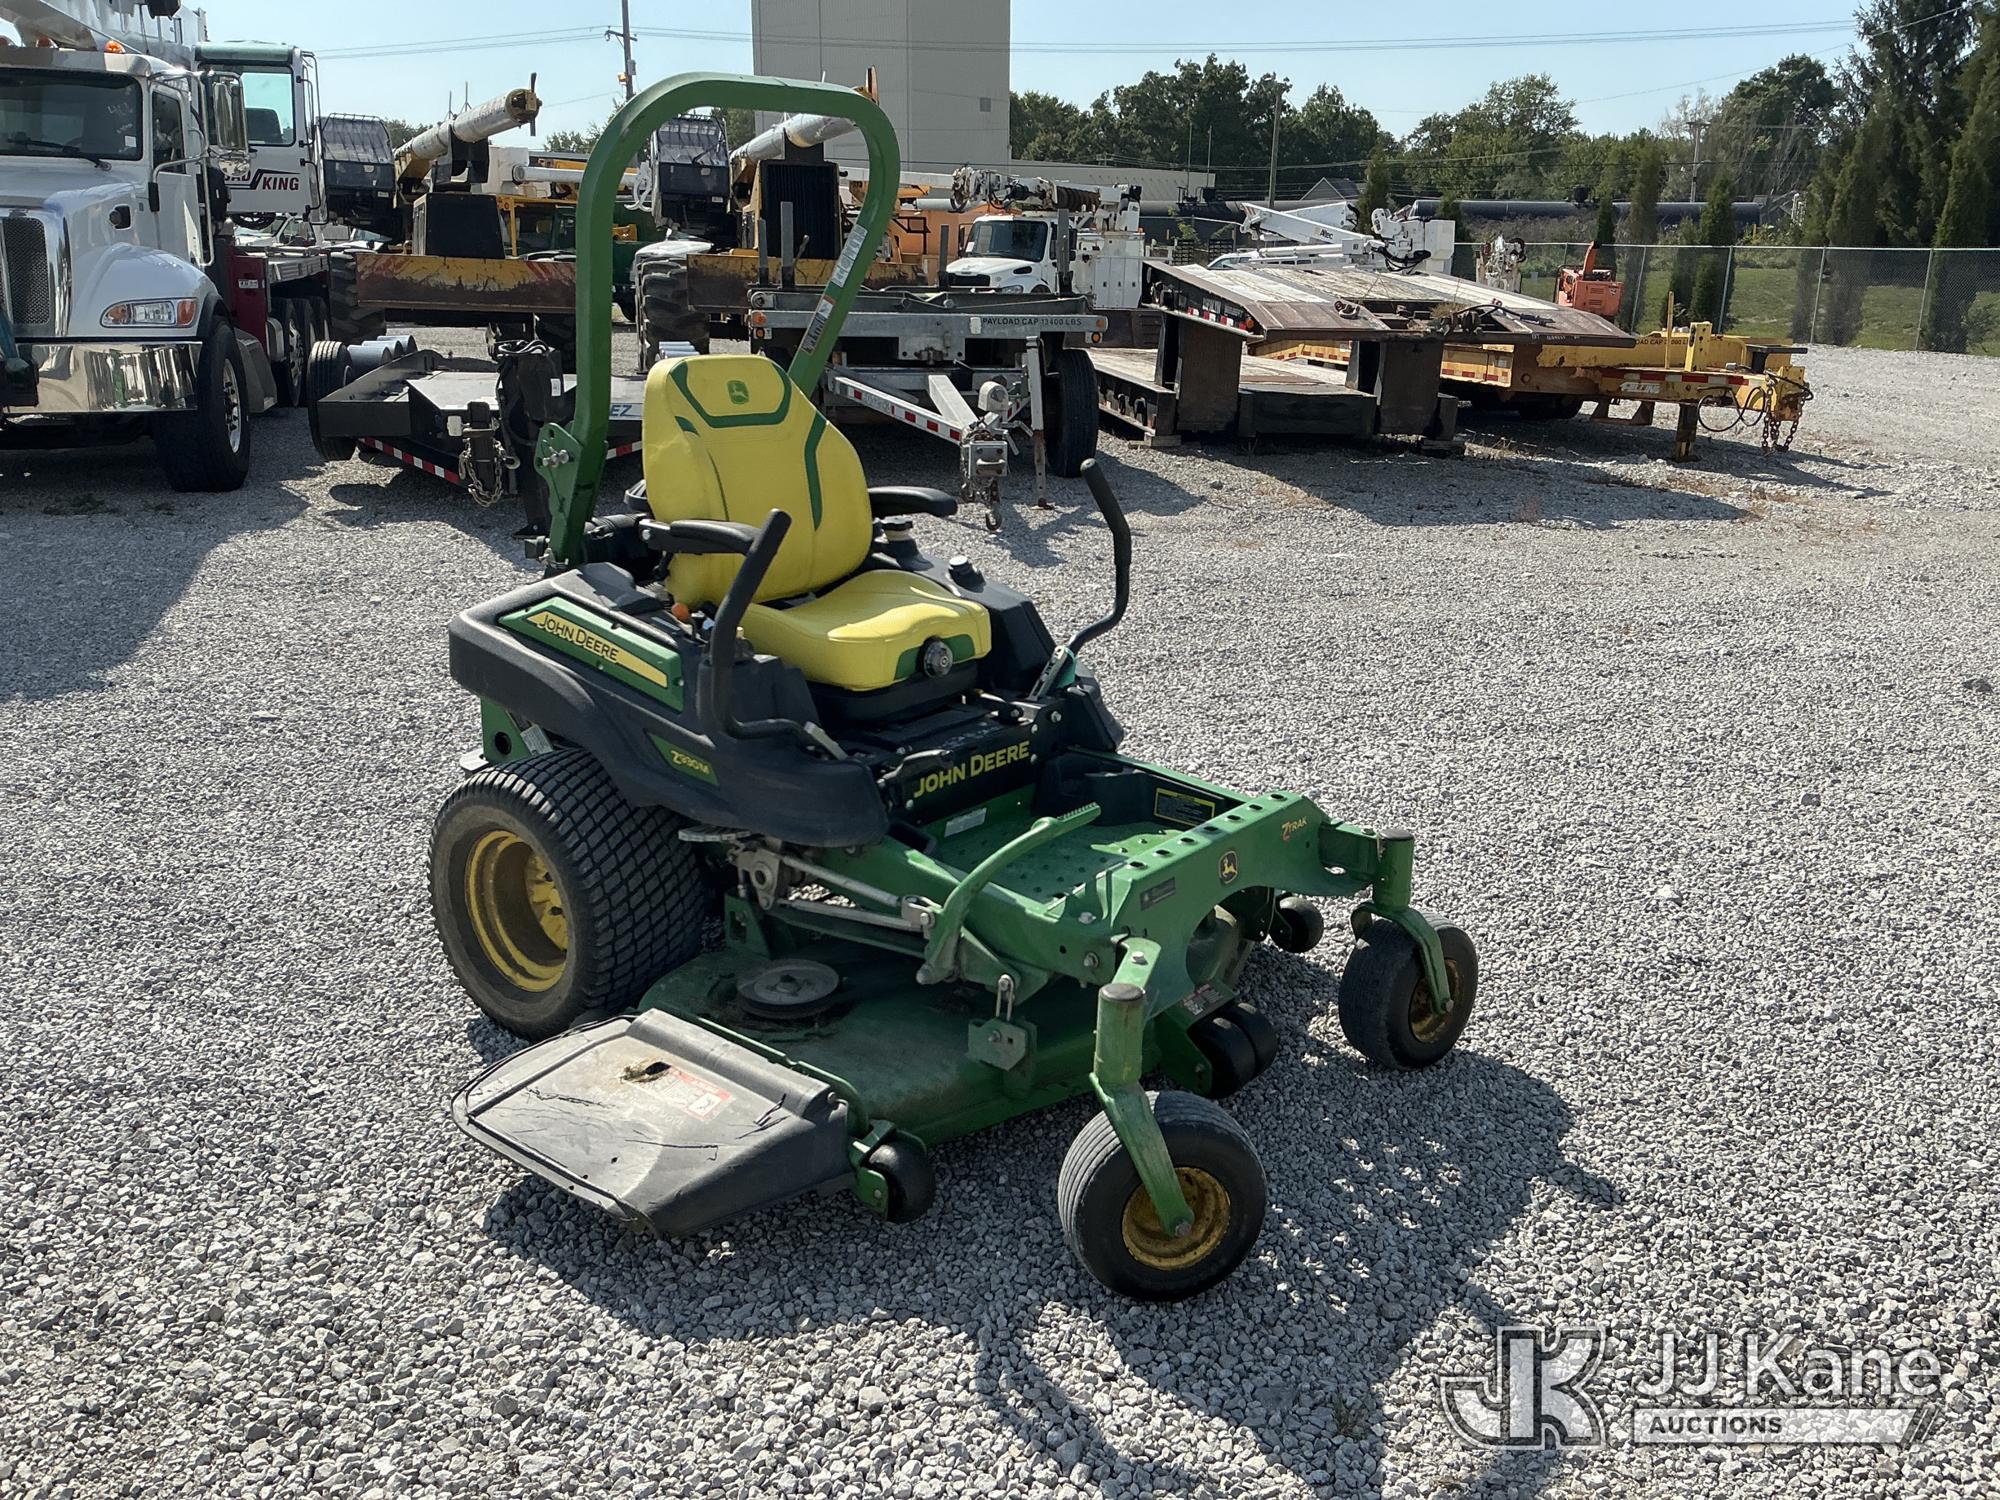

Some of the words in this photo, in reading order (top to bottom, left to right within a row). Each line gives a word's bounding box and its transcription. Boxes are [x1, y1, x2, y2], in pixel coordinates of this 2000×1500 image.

[262, 176, 299, 190] KING
[982, 317, 1019, 325] PAYLOAD
[1021, 317, 1039, 326] CAP
[1065, 318, 1082, 326] LBS
[538, 613, 575, 640] JOHN
[575, 628, 620, 662] DEERE
[913, 762, 966, 798] JOHN
[970, 740, 1030, 777] DEERE
